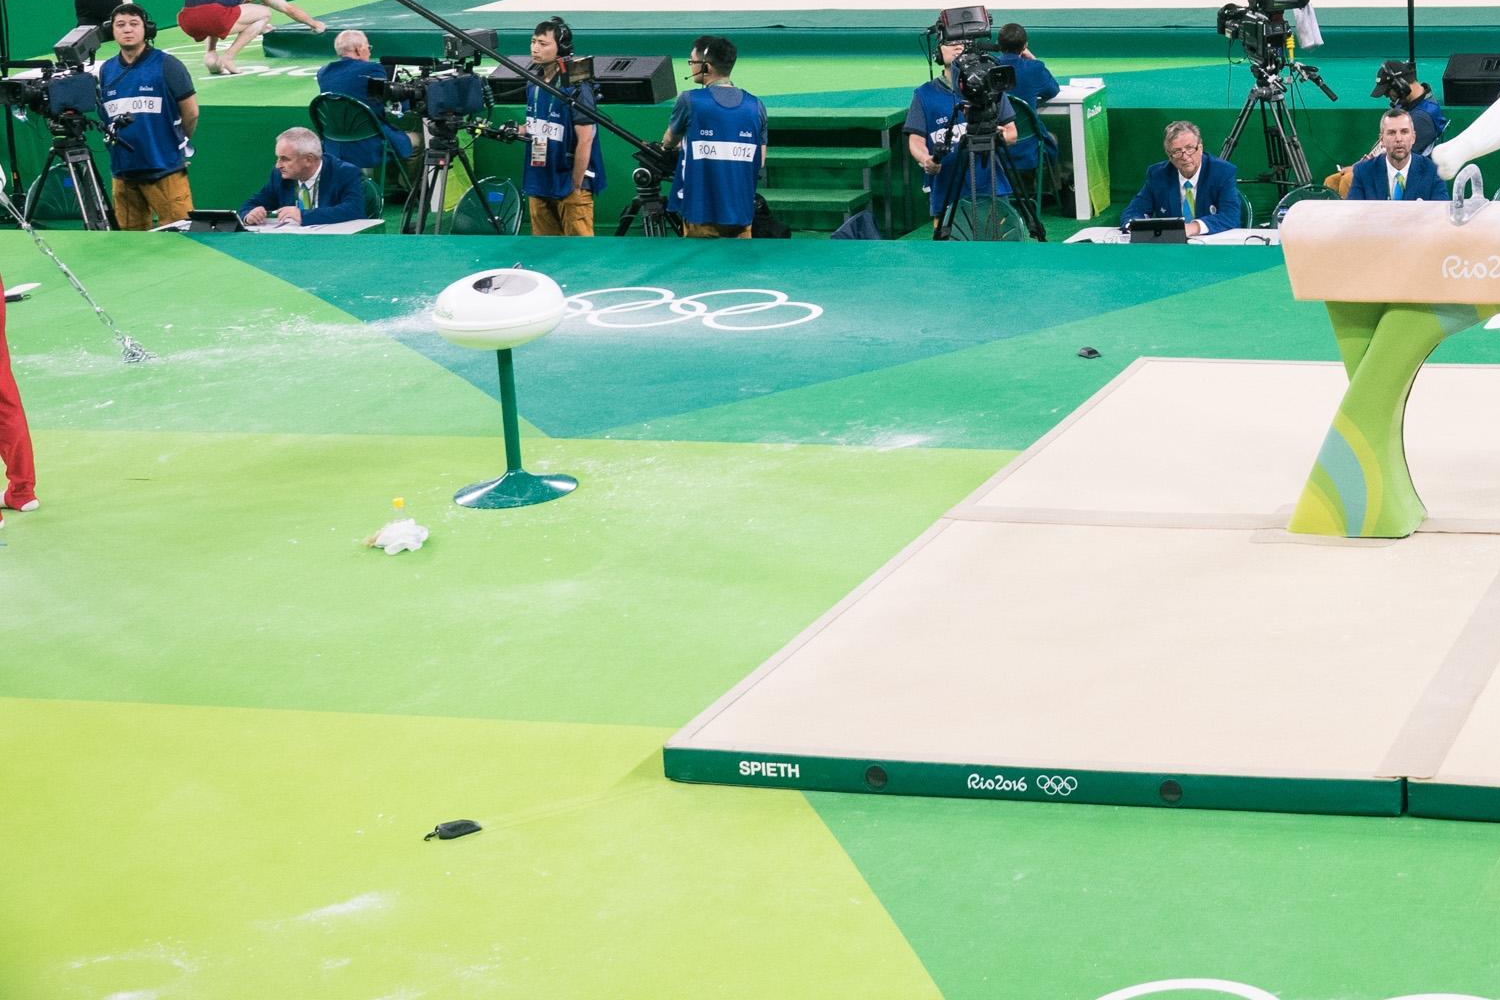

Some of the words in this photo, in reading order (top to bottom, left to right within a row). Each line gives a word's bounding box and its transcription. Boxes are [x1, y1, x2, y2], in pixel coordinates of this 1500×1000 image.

[132, 100, 154, 110] 0018
[936, 116, 948, 124] OBS
[699, 144, 717, 155] ROA
[733, 146, 751, 158] 0012
[739, 760, 800, 778] SPIETH
[967, 773, 1028, 792] Rio2016
